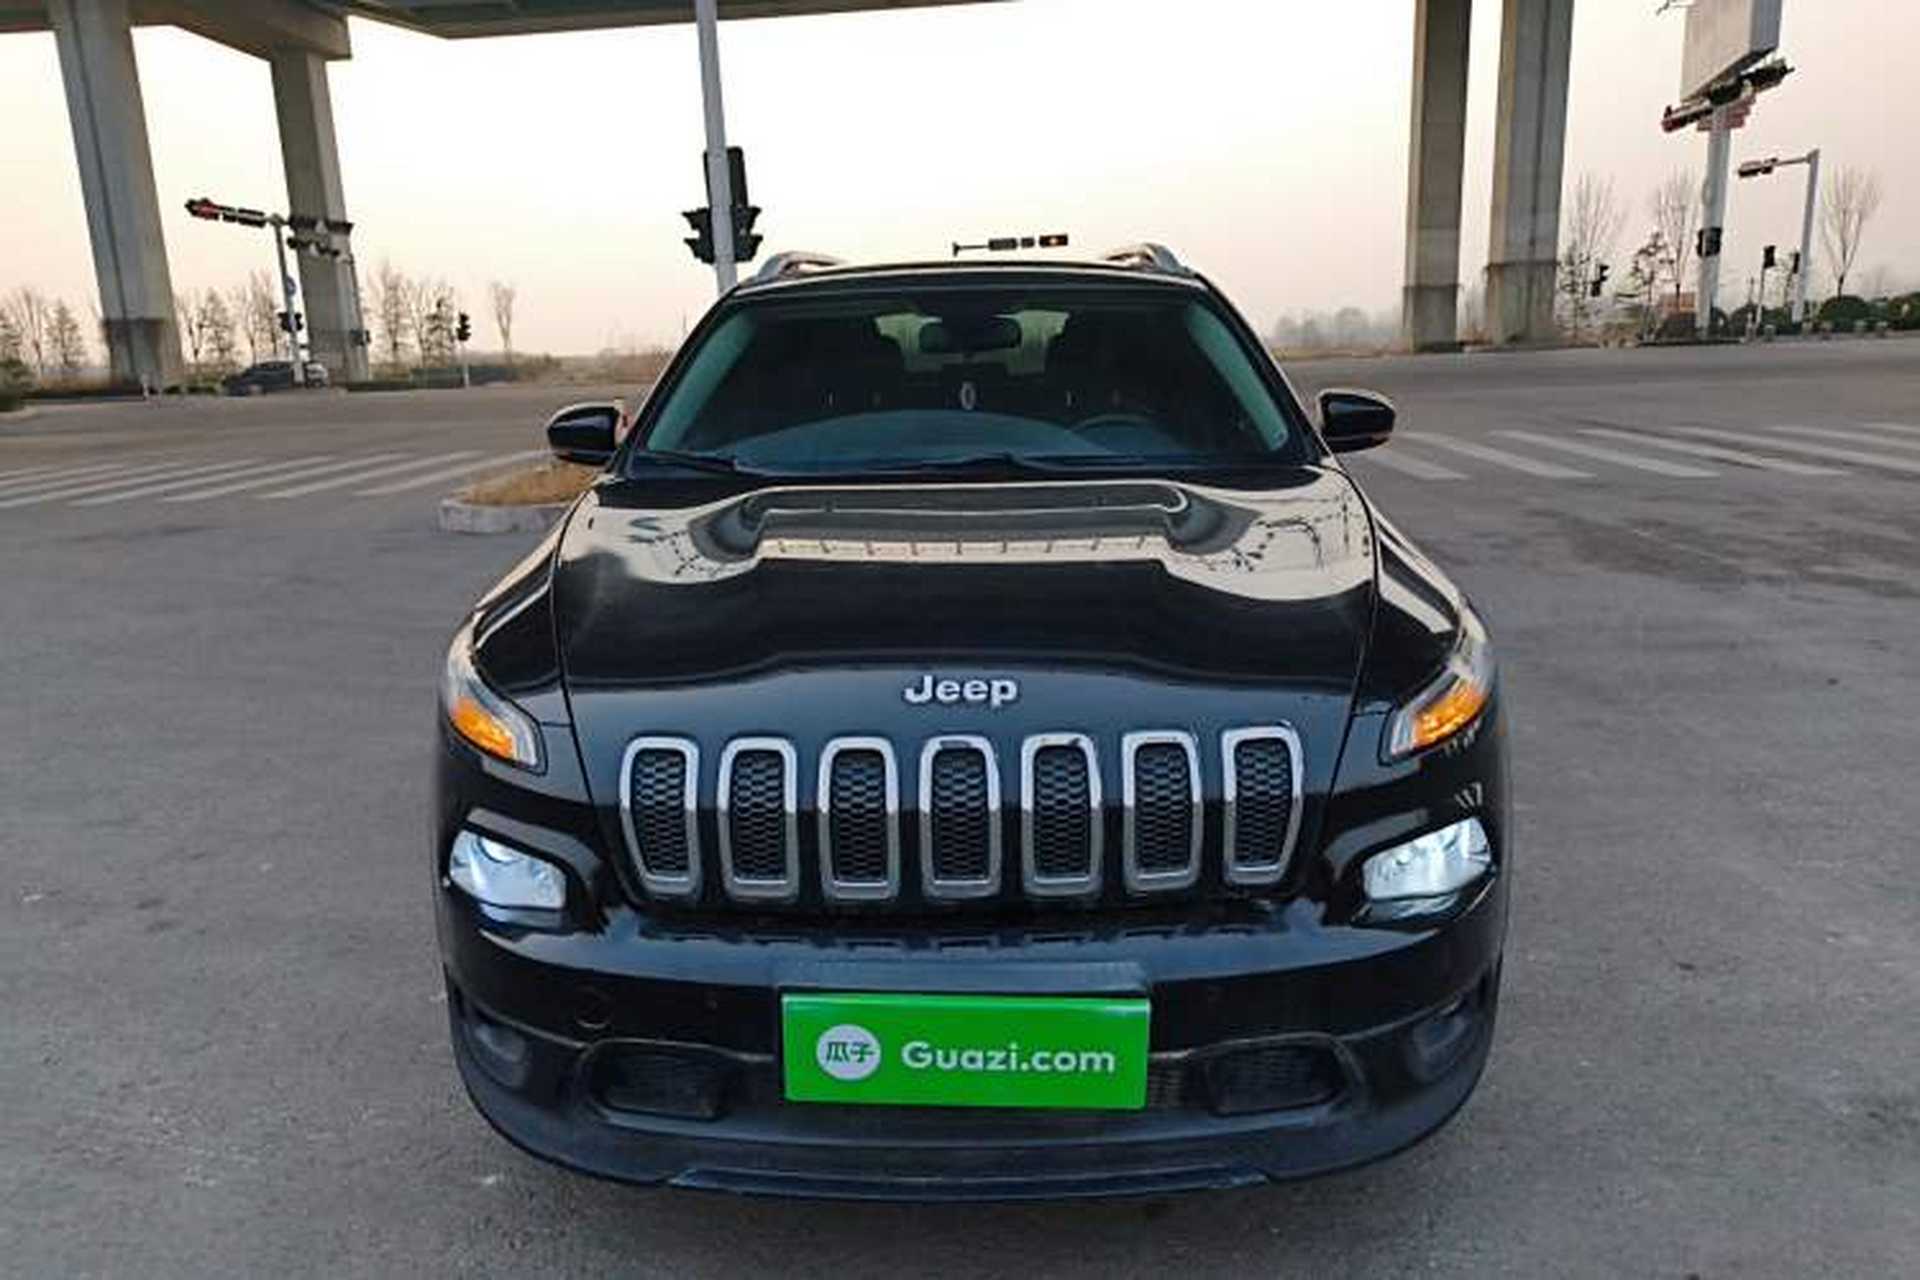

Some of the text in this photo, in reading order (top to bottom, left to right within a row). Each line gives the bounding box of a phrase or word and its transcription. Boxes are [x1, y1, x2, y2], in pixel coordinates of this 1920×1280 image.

[904, 675, 1018, 706] Jeep
[825, 1040, 875, 1063] 瓜子
[901, 1040, 1116, 1074] Guazi.com
